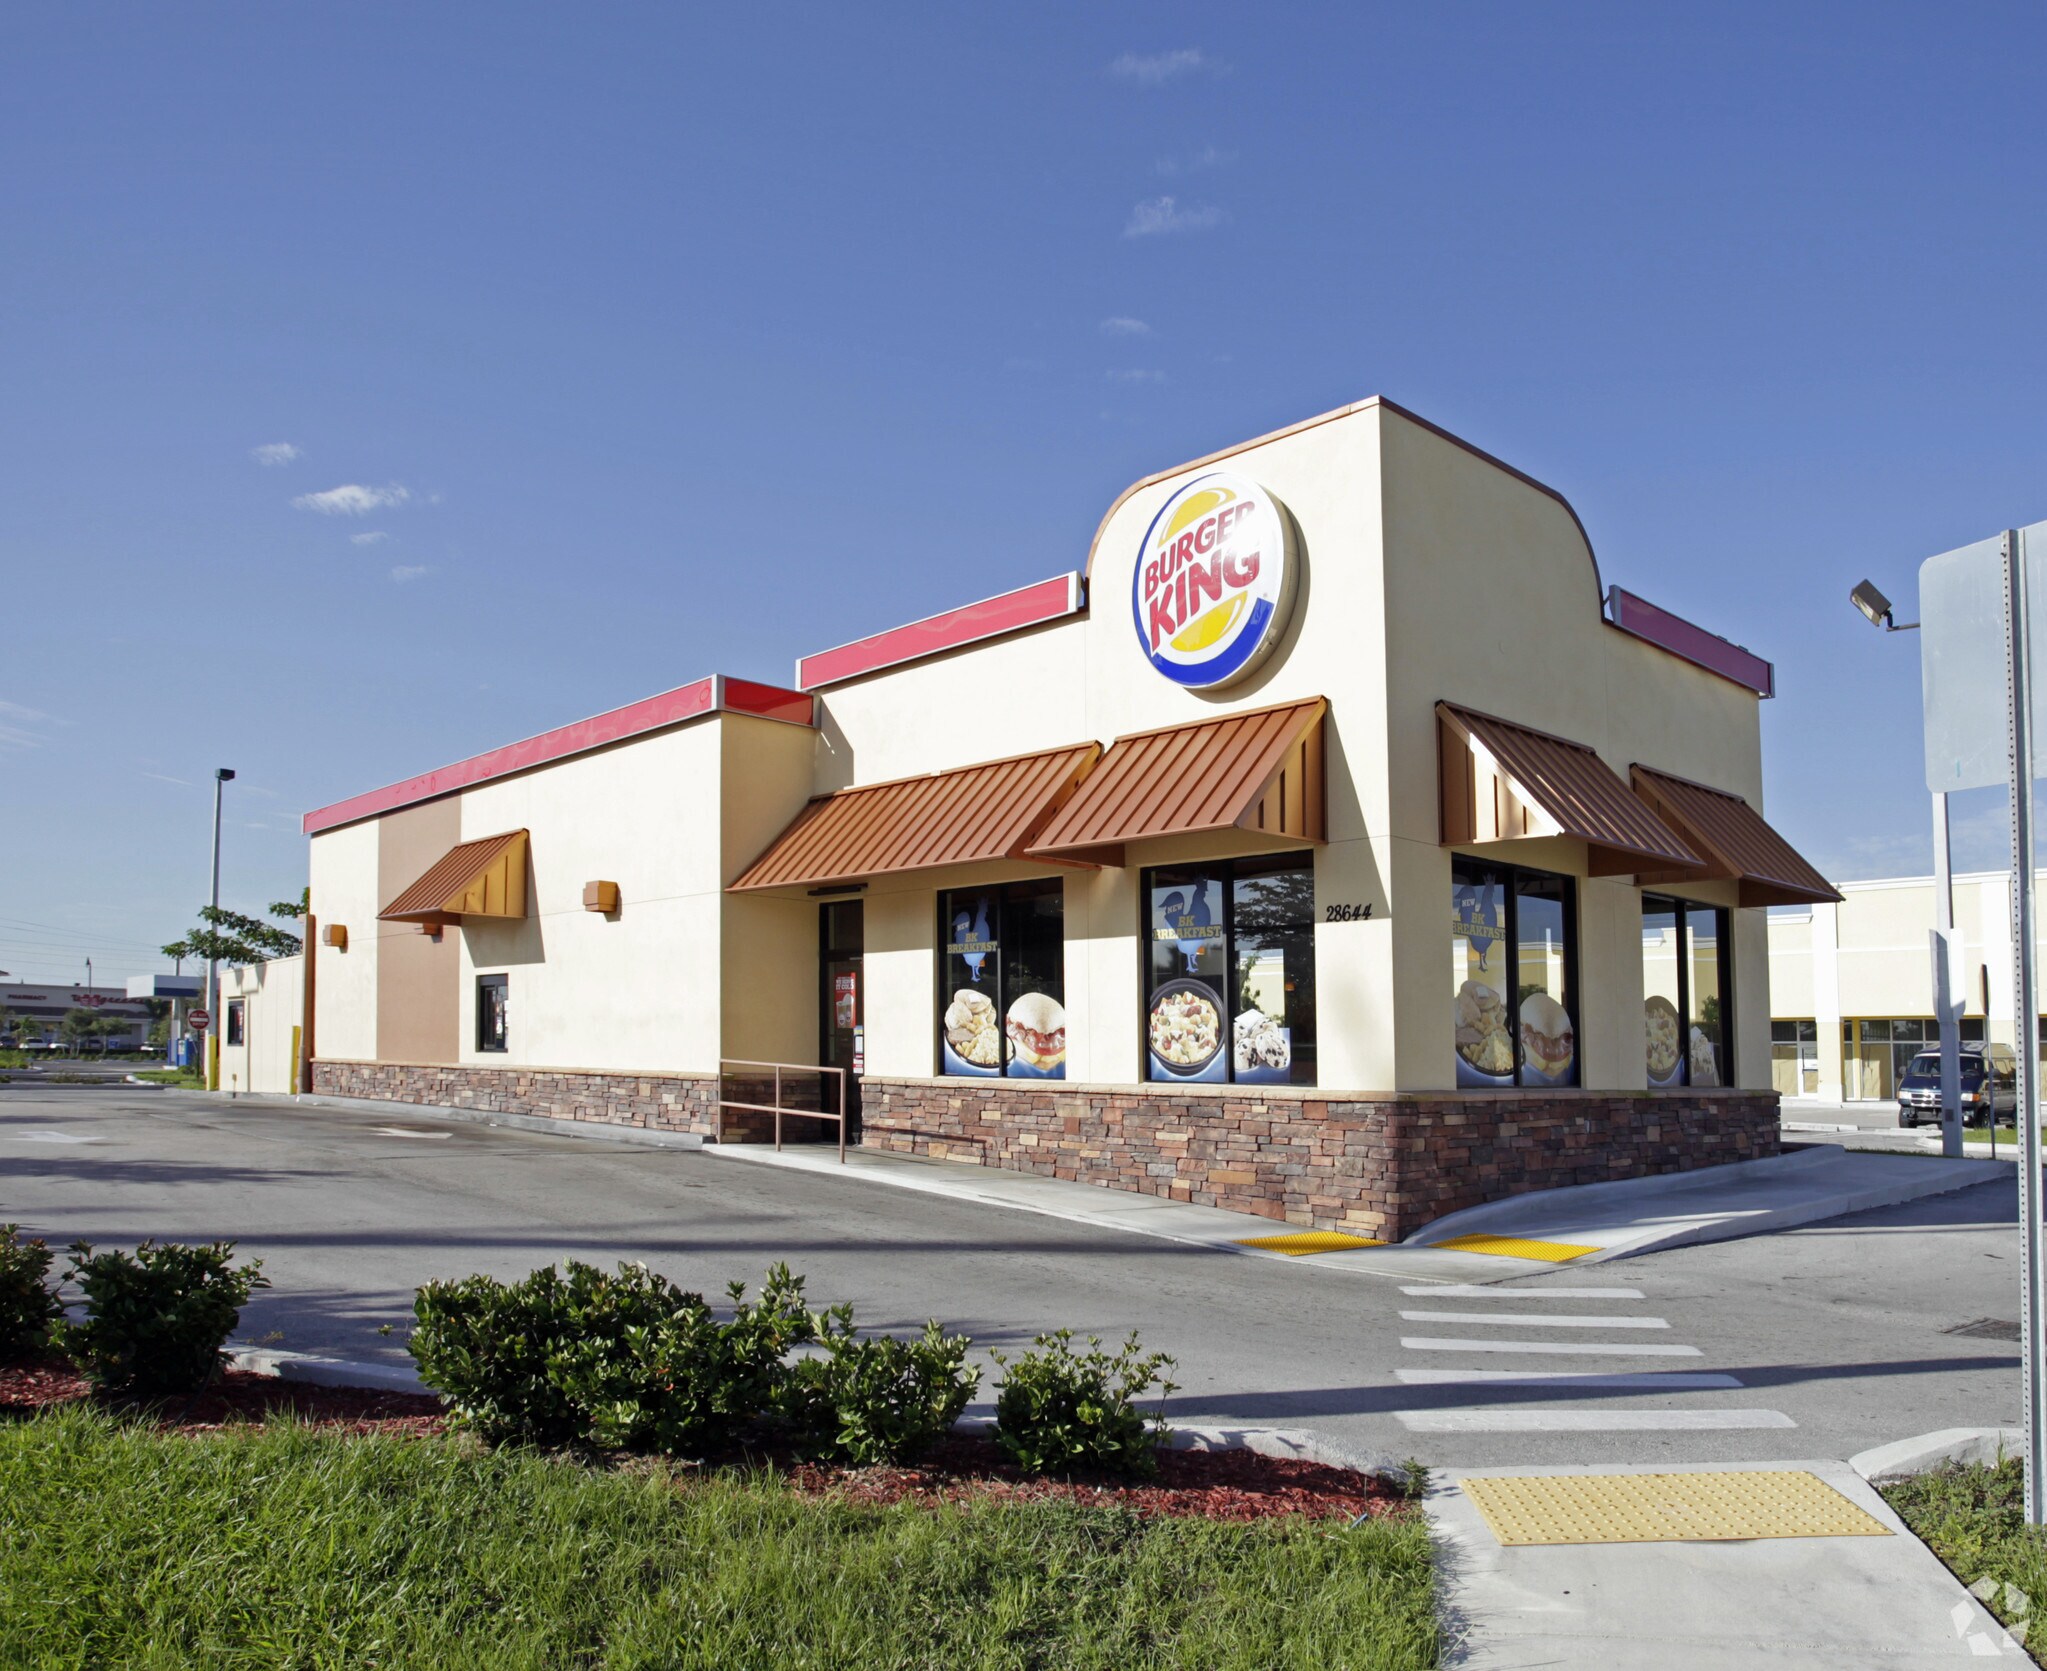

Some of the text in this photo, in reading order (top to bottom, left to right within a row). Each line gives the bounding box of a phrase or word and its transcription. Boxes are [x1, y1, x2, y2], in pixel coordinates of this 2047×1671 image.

[1150, 548, 1260, 652] KING
[1167, 902, 1184, 913] NEW
[1461, 898, 1475, 907] NEW
[1326, 903, 1372, 922] 28644
[1471, 912, 1485, 924] BK
[957, 921, 970, 931] NEW
[1178, 914, 1195, 927] BK
[965, 932, 978, 943] BK
[1152, 925, 1222, 940] BREAKFAST
[946, 941, 998, 954] BREAKFAST
